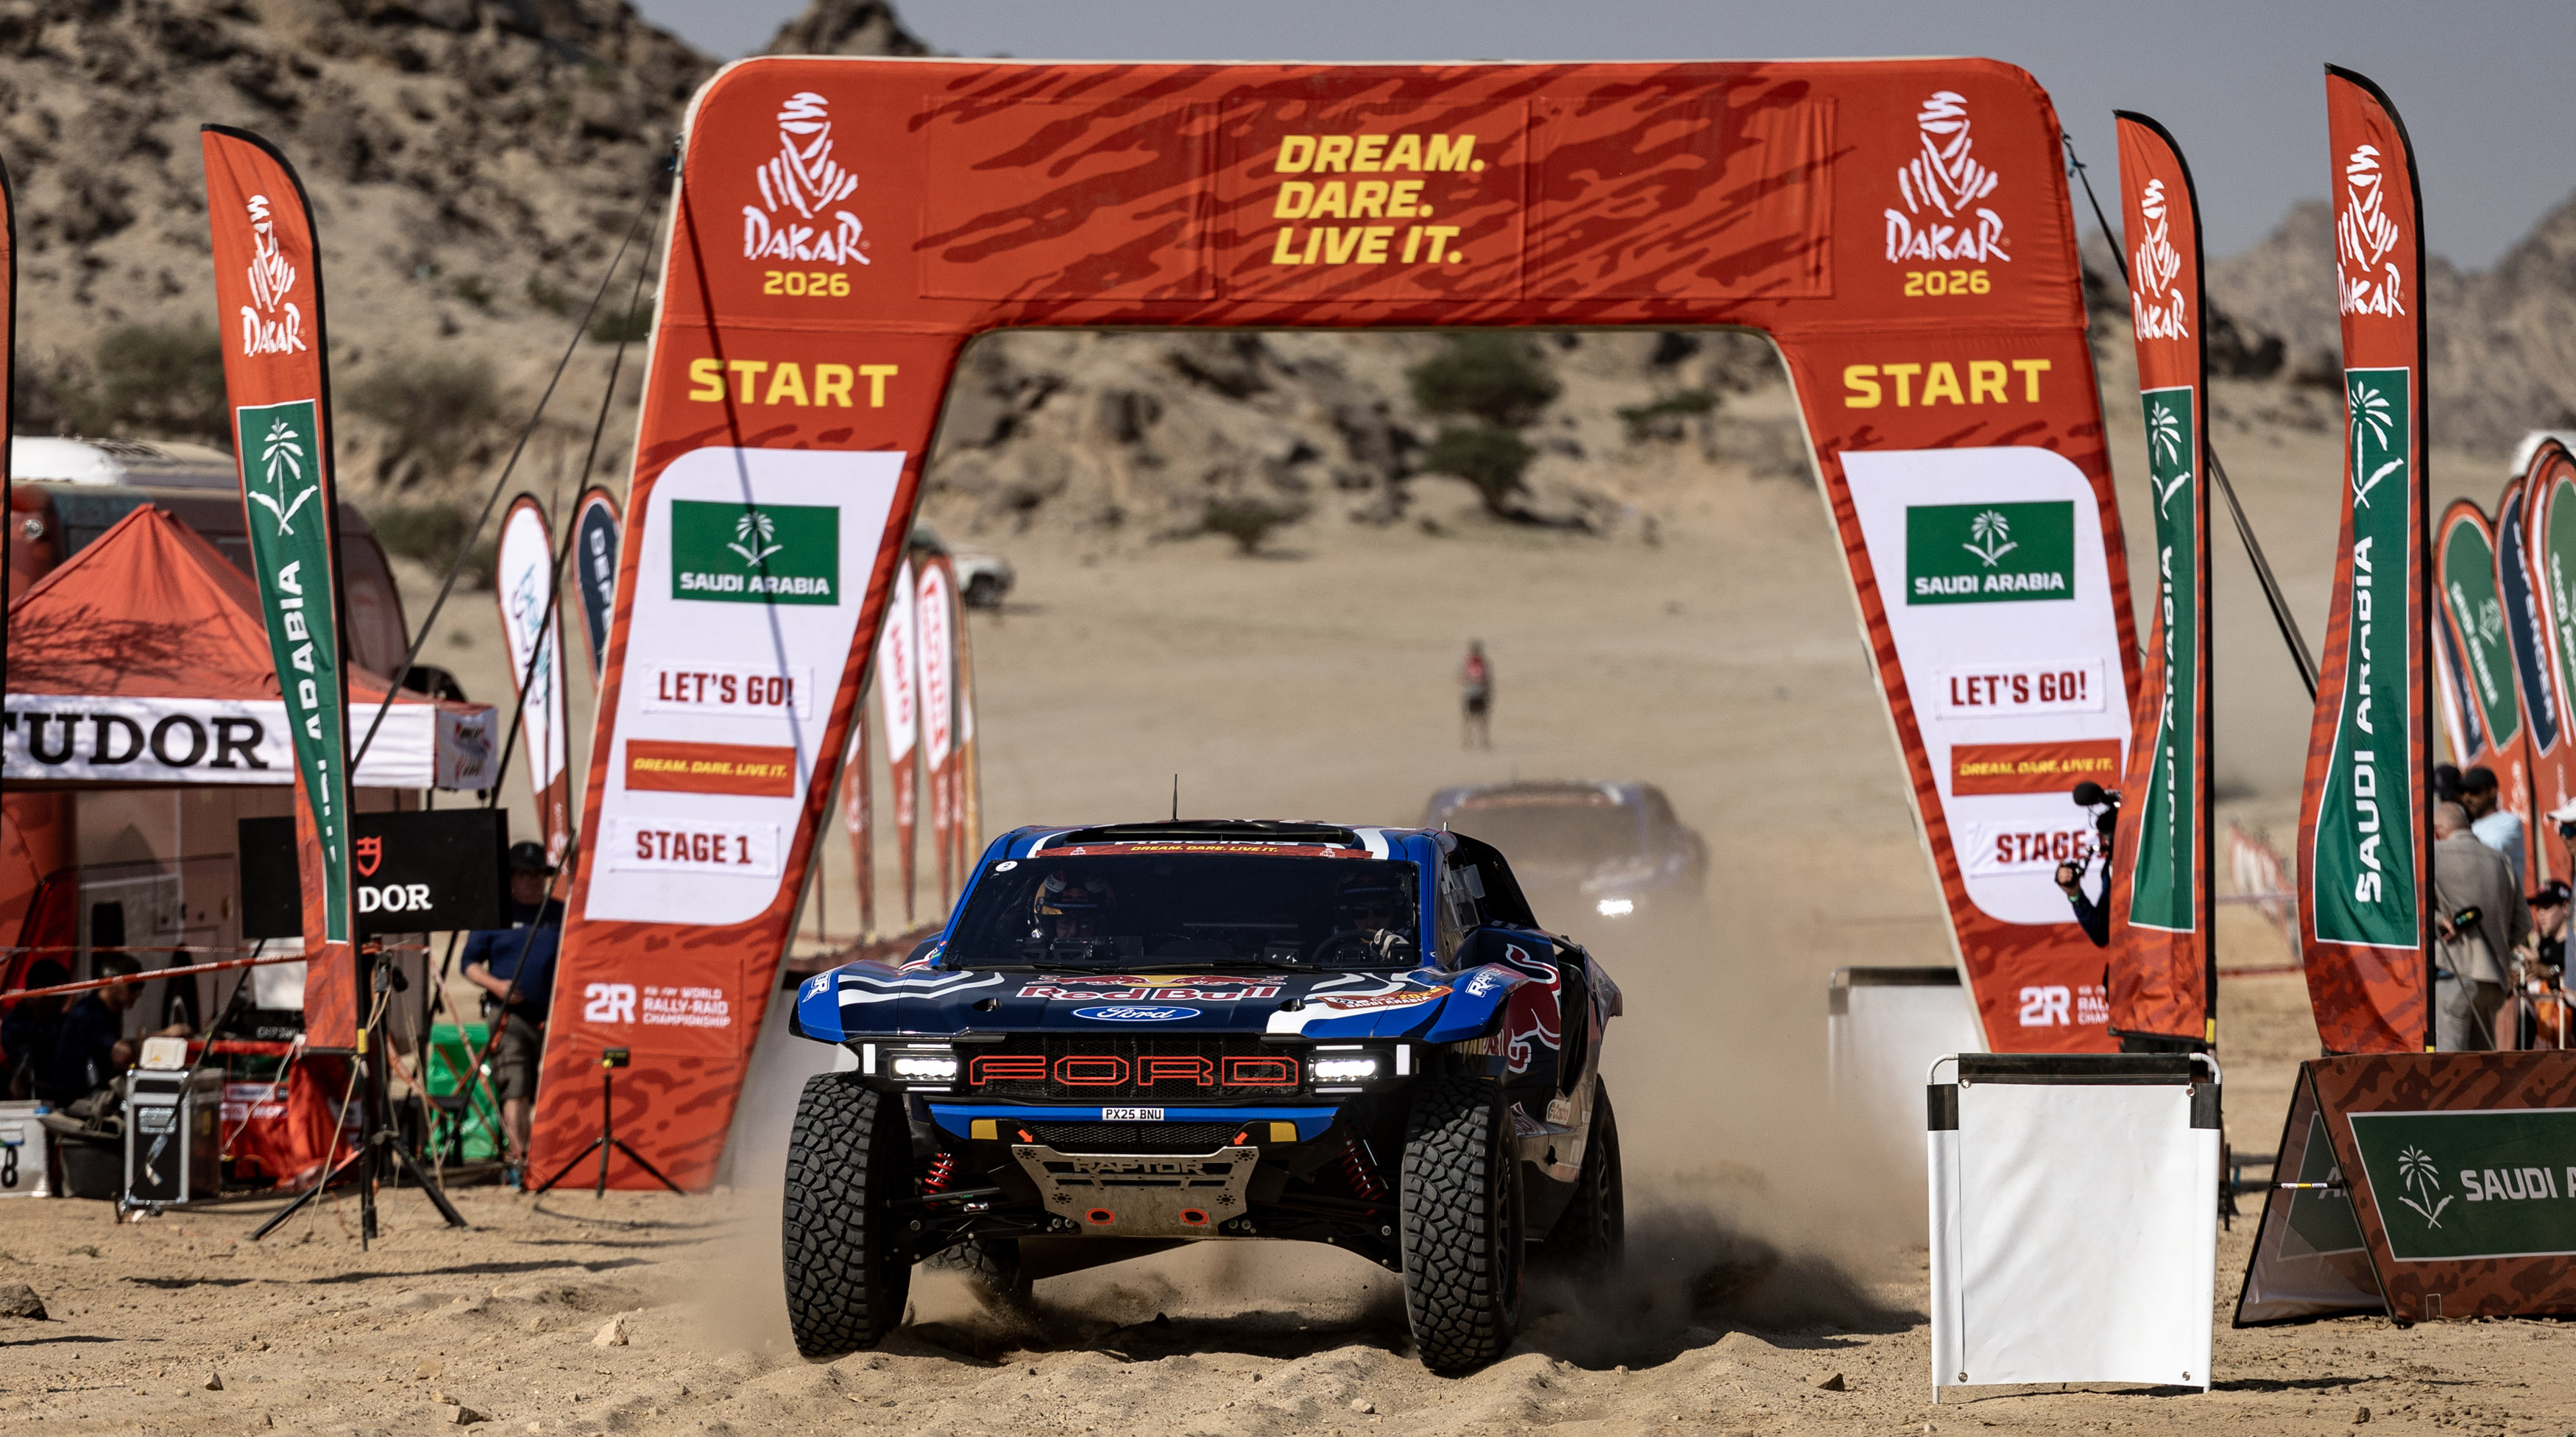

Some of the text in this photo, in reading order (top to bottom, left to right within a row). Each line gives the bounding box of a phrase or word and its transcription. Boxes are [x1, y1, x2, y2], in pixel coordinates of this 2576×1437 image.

[1275, 134, 1485, 173] DREAM.
[1273, 180, 1434, 219] DARE.
[743, 205, 870, 266] DAKAR
[1271, 225, 1463, 265] LIVE IT.
[1884, 208, 2011, 264] DAKAR
[763, 270, 850, 297] 2026
[1904, 269, 1990, 297] 2026
[2336, 261, 2406, 318] DAKAR
[241, 302, 307, 358] DAKAR
[2132, 286, 2189, 342] DAKAR
[688, 358, 899, 408] START
[1844, 359, 2052, 409] START
[680, 572, 830, 595] SAUDI ARABIA
[1916, 572, 2065, 594] SAUDI ARABIA
[659, 671, 793, 708] LET'S GO!
[1951, 671, 2087, 706] LET'S GO!
[2354, 535, 2382, 903] SAUDI ARABIA
[633, 758, 690, 772] DREAM.
[690, 760, 734, 774] DARE.
[735, 763, 768, 777] LIVE
[1960, 762, 2015, 776] DREAM.
[2017, 760, 2060, 774] DARE.
[2062, 758, 2095, 772] LIVE
[637, 830, 752, 864] STAGE 1
[1997, 830, 2087, 863] STAGE
[358, 883, 434, 913] DOR
[1016, 986, 1281, 1001] Red Bull
[1345, 996, 1432, 1009] SAUDI ARABIA
[1098, 1007, 1176, 1020] Ford
[970, 1055, 1299, 1087] FORD
[1105, 1109, 1162, 1120] PX25 BNU
[1072, 1161, 1209, 1176] RAPTOR
[2460, 1167, 2558, 1201] SAUDI
